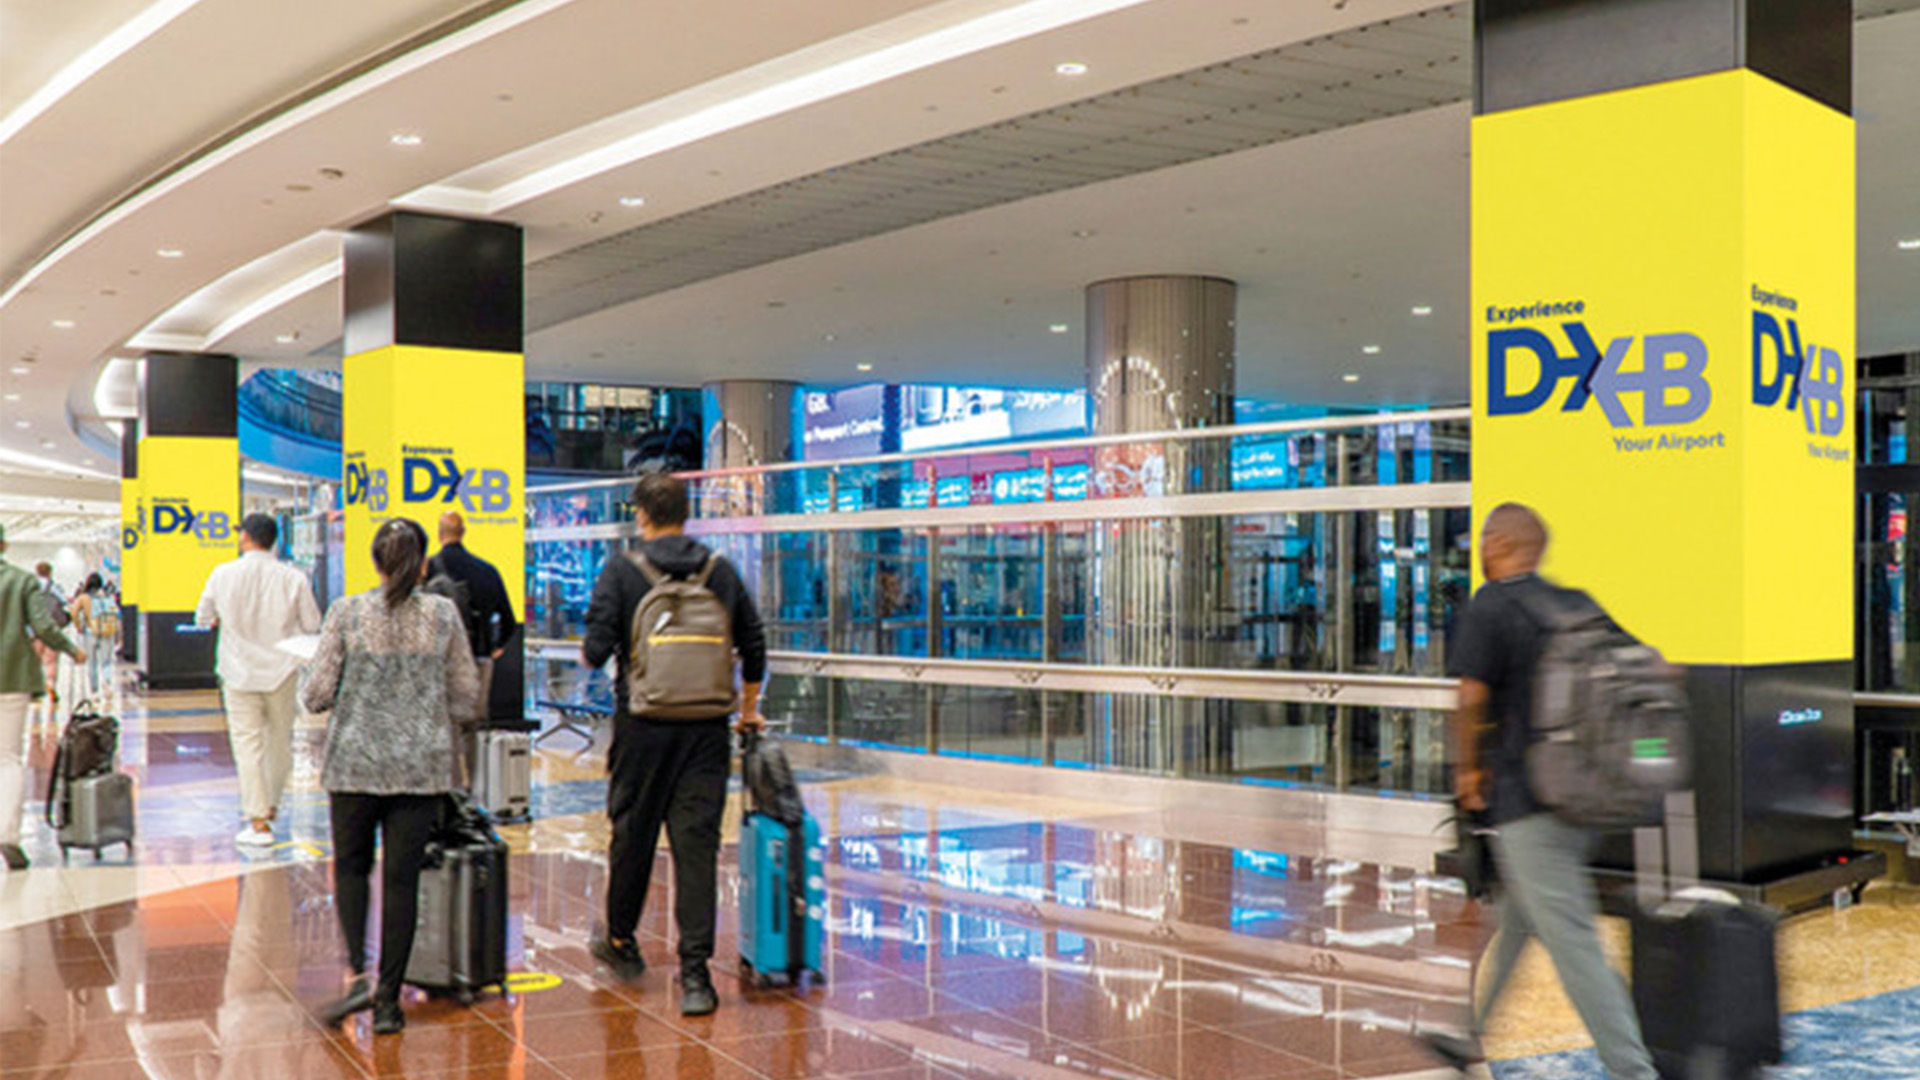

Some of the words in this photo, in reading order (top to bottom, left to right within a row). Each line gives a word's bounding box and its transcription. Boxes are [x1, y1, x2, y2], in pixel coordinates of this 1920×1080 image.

[1486, 300, 1585, 323] Experience
[1487, 322, 1712, 428] DXB
[1752, 310, 1845, 437] DXB
[1612, 435, 1653, 452] Your
[1656, 432, 1725, 452] Airport
[346, 461, 389, 511] DXB
[402, 457, 512, 513] DXB
[153, 505, 230, 539] DXB
